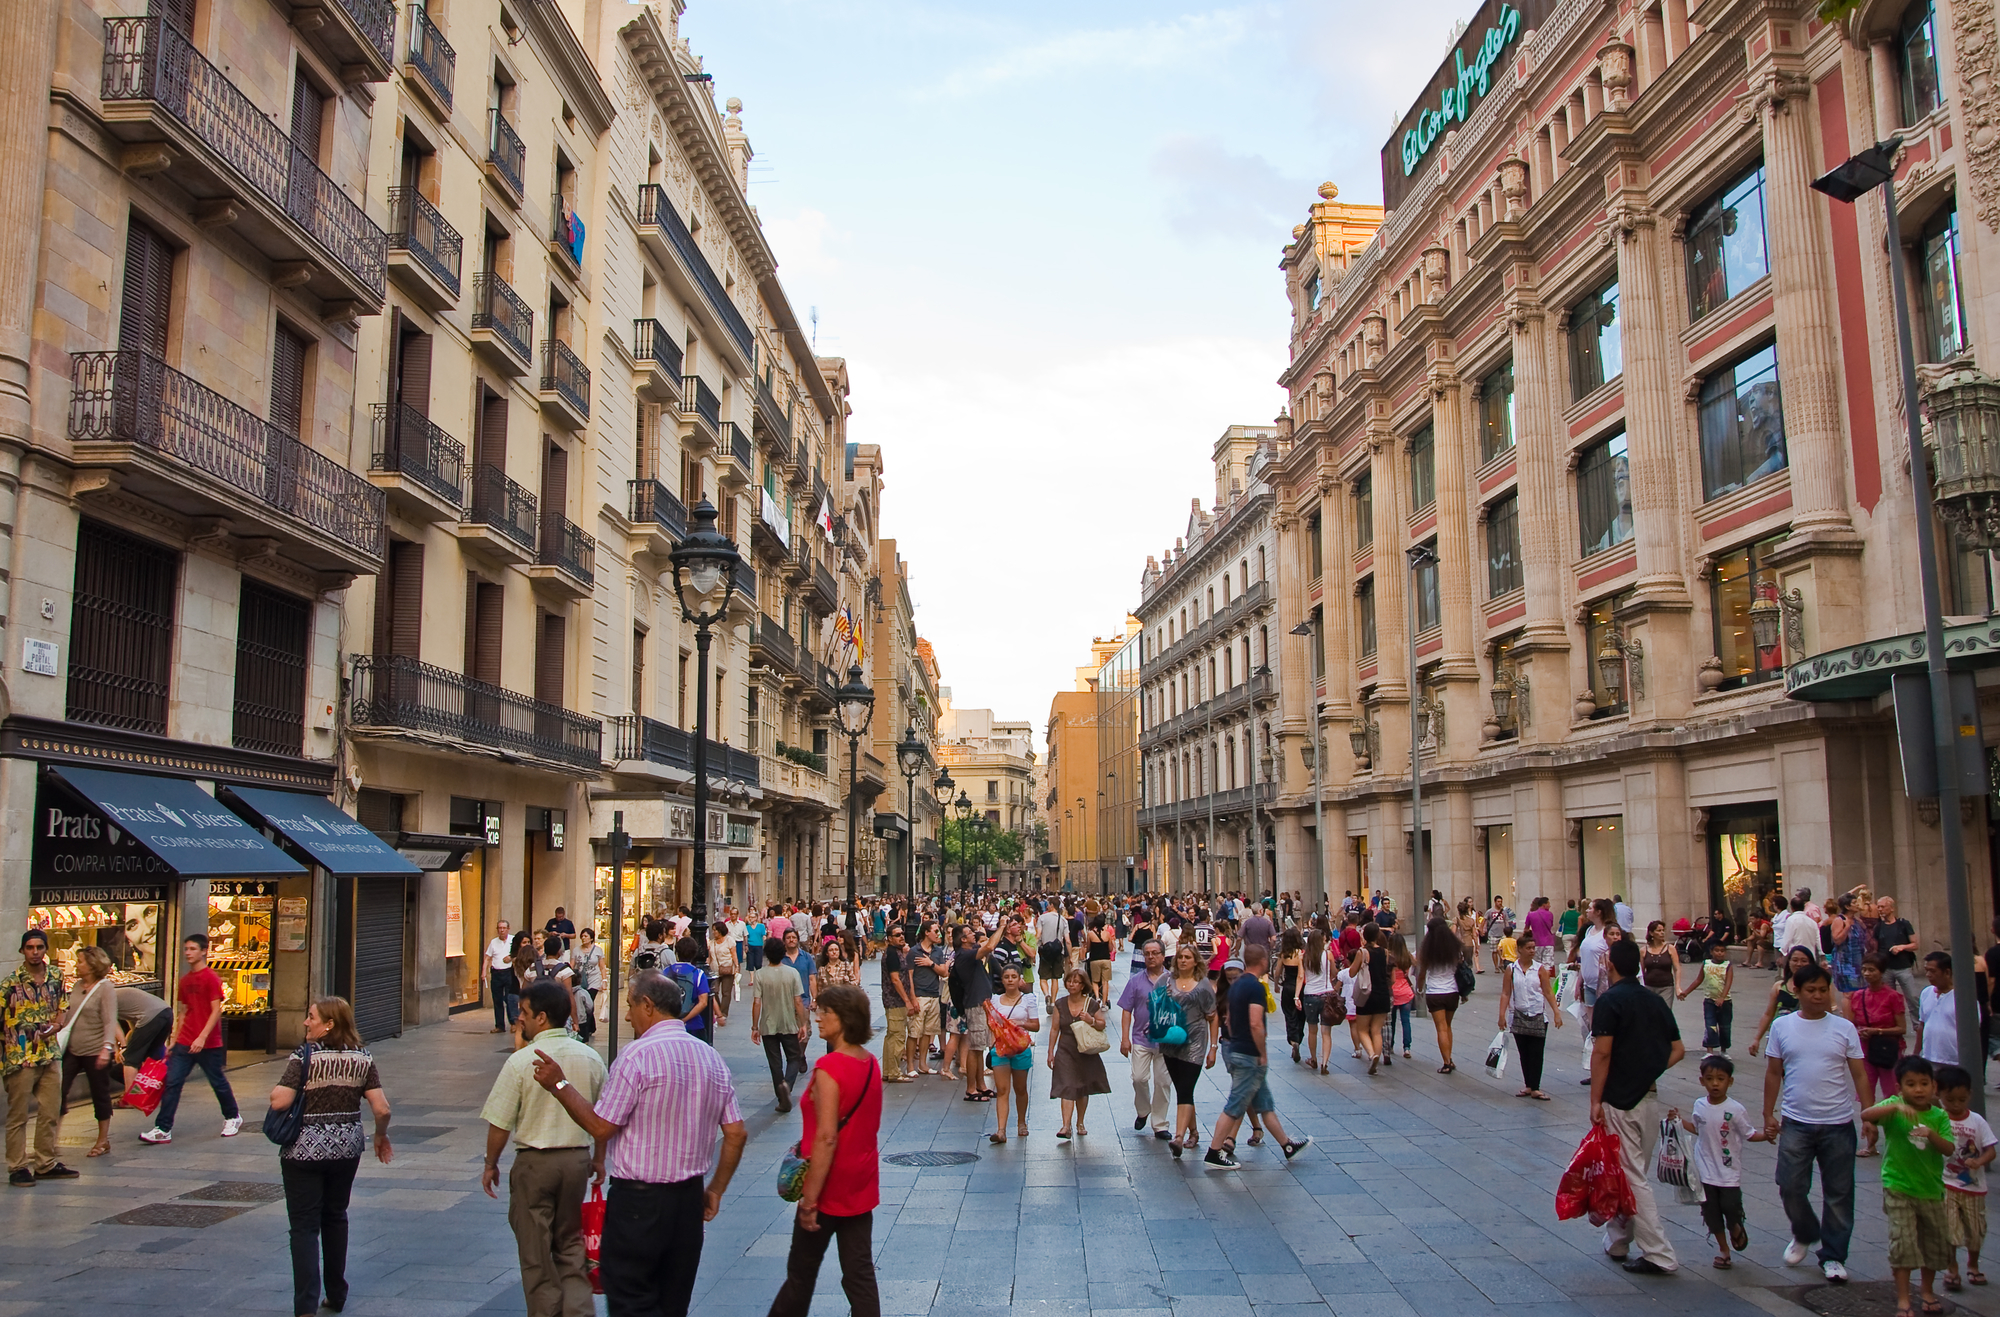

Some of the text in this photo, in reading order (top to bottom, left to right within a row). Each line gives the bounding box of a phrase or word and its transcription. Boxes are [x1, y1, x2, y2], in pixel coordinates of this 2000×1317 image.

[1402, 129, 1421, 177] El
[1417, 87, 1456, 155] Corte
[31, 653, 51, 665] PORTAL
[38, 648, 46, 656] DEL
[26, 661, 34, 670] DE
[100, 801, 243, 829] Prats Joiers
[47, 808, 101, 839] Prats
[265, 814, 369, 837] Prats Joiers
[151, 835, 265, 850] COMPRA VENTA ORO
[309, 841, 346, 853] COMPRA
[54, 854, 107, 873] COMPRA
[109, 855, 143, 872] VENTA
[40, 887, 150, 903] LOS MEJORES PRECIOS
[1199, 930, 1205, 942] 9
